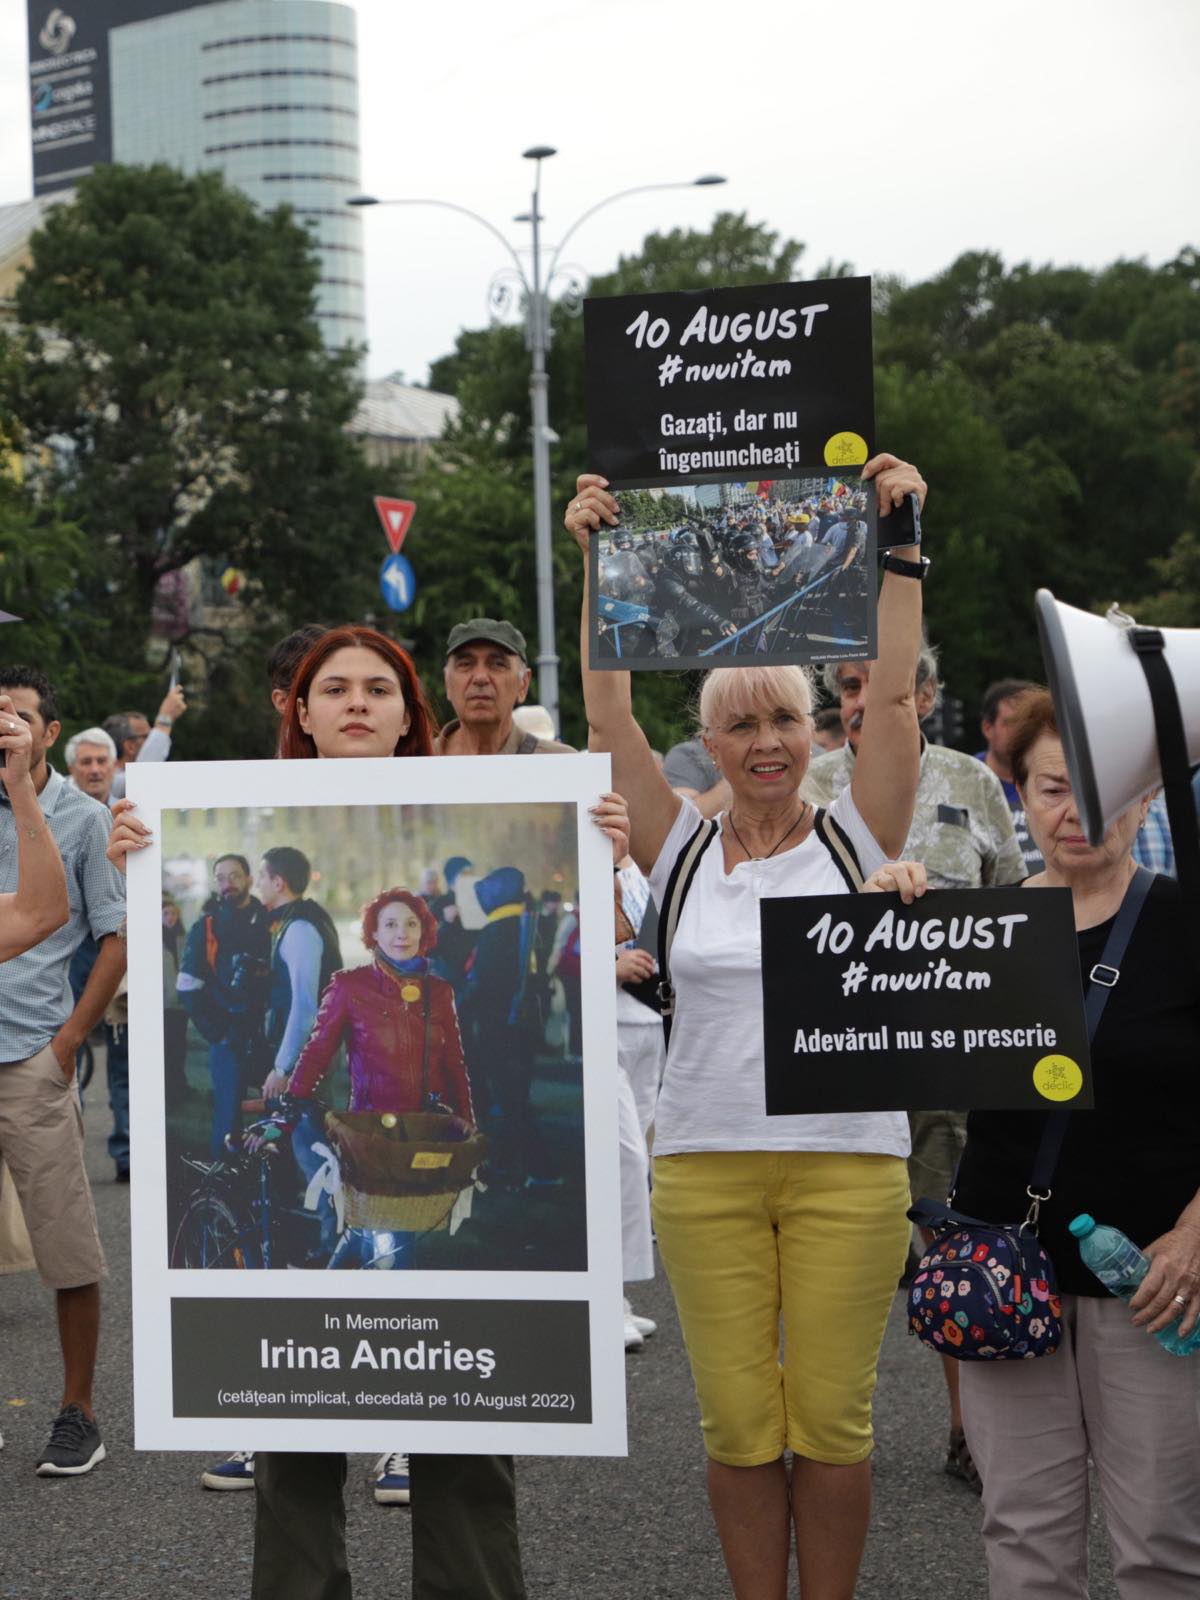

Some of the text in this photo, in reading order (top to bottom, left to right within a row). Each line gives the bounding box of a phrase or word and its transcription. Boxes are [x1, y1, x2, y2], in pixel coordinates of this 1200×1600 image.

[625, 303, 829, 349] 10 AUGUST
[660, 408, 798, 441] Gazați, dar nu
[658, 437, 800, 474] îngenuncheați
[806, 909, 1029, 955] 10 AUGUST
[793, 1022, 1057, 1054] Adevărul nu se prescrie
[324, 1313, 439, 1331] In Memoriam
[261, 1338, 341, 1370] Irina
[290, 1390, 351, 1407] implicat,
[355, 1391, 424, 1406] decedată
[428, 1394, 447, 1409] pe
[452, 1392, 471, 1407] 10
[473, 1392, 527, 1410] August
[531, 1393, 575, 1411] 2022)
